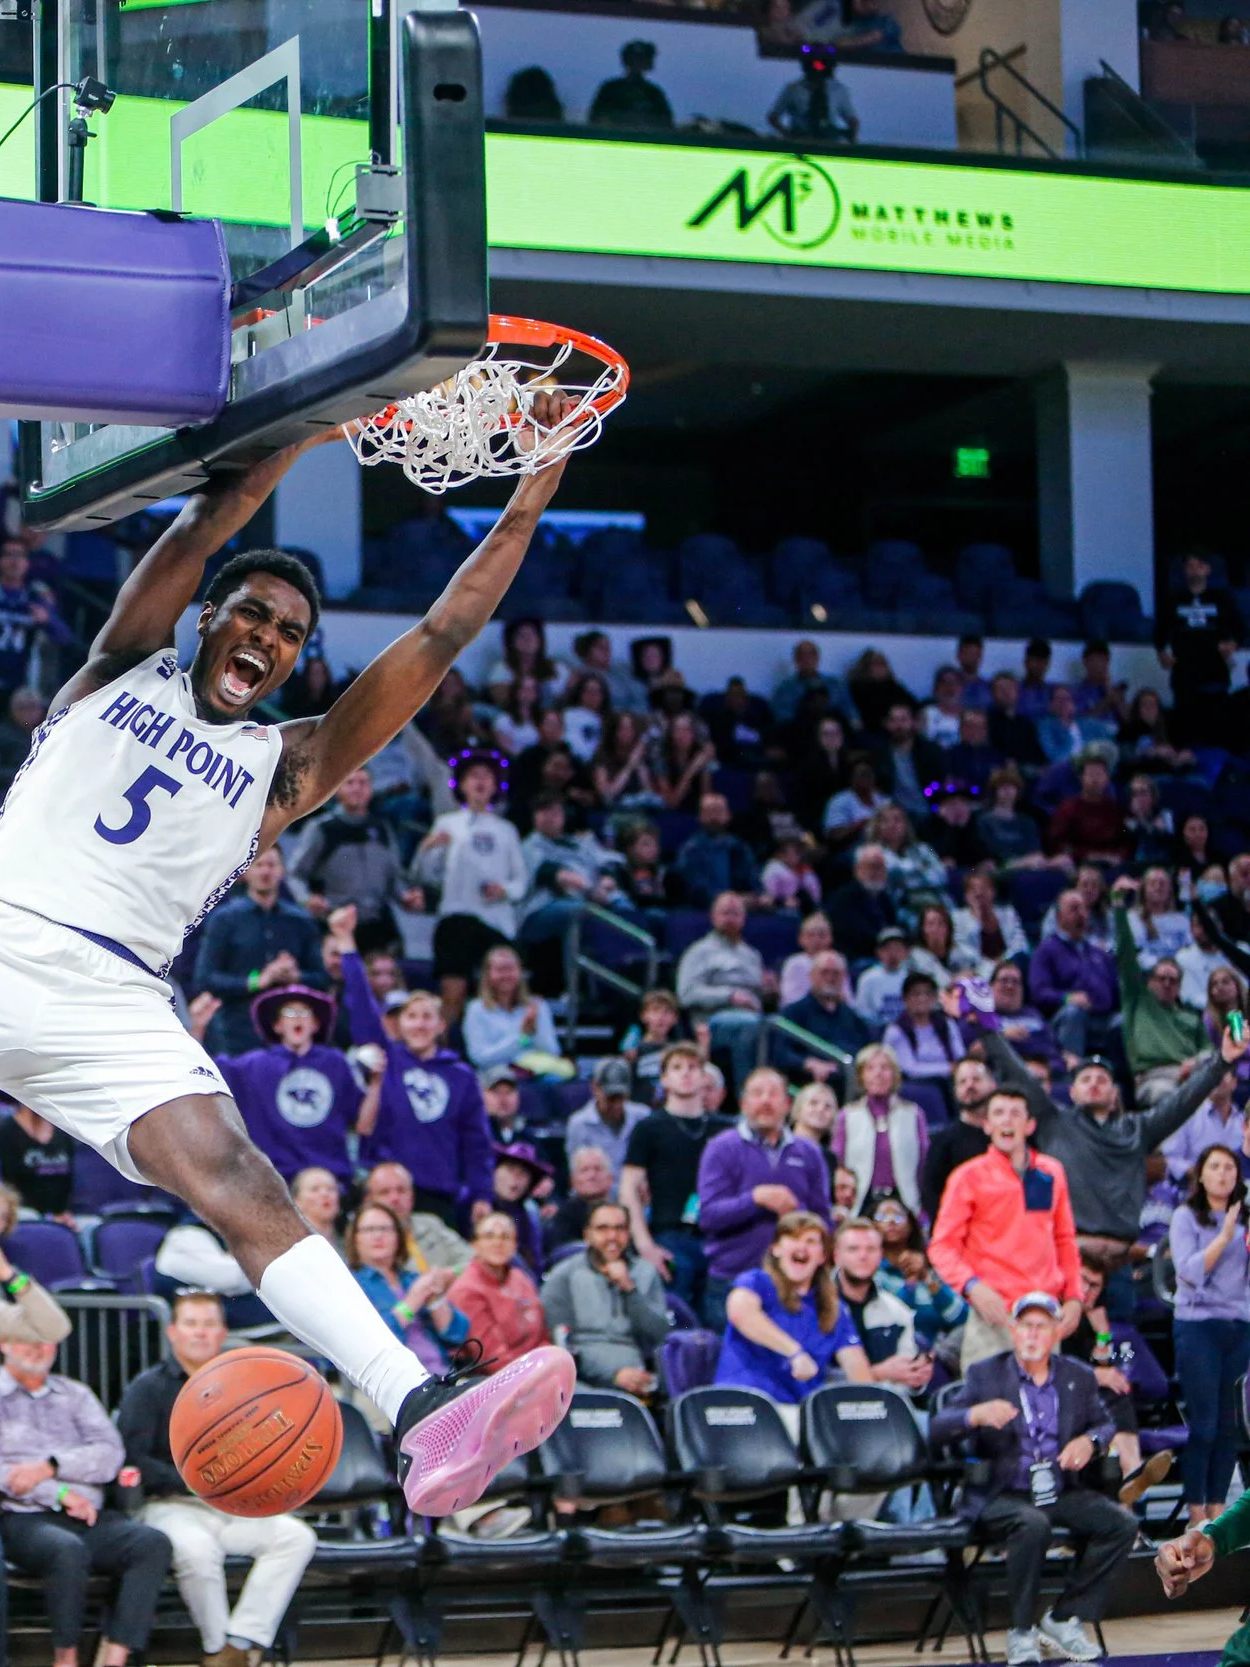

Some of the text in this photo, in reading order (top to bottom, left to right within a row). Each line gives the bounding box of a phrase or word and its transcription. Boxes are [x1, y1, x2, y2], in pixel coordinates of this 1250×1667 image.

[851, 203, 1014, 231] MATTHEWS
[851, 226, 932, 247] MOBILE
[98, 691, 255, 810] HIGH POINT
[93, 764, 183, 845] 5
